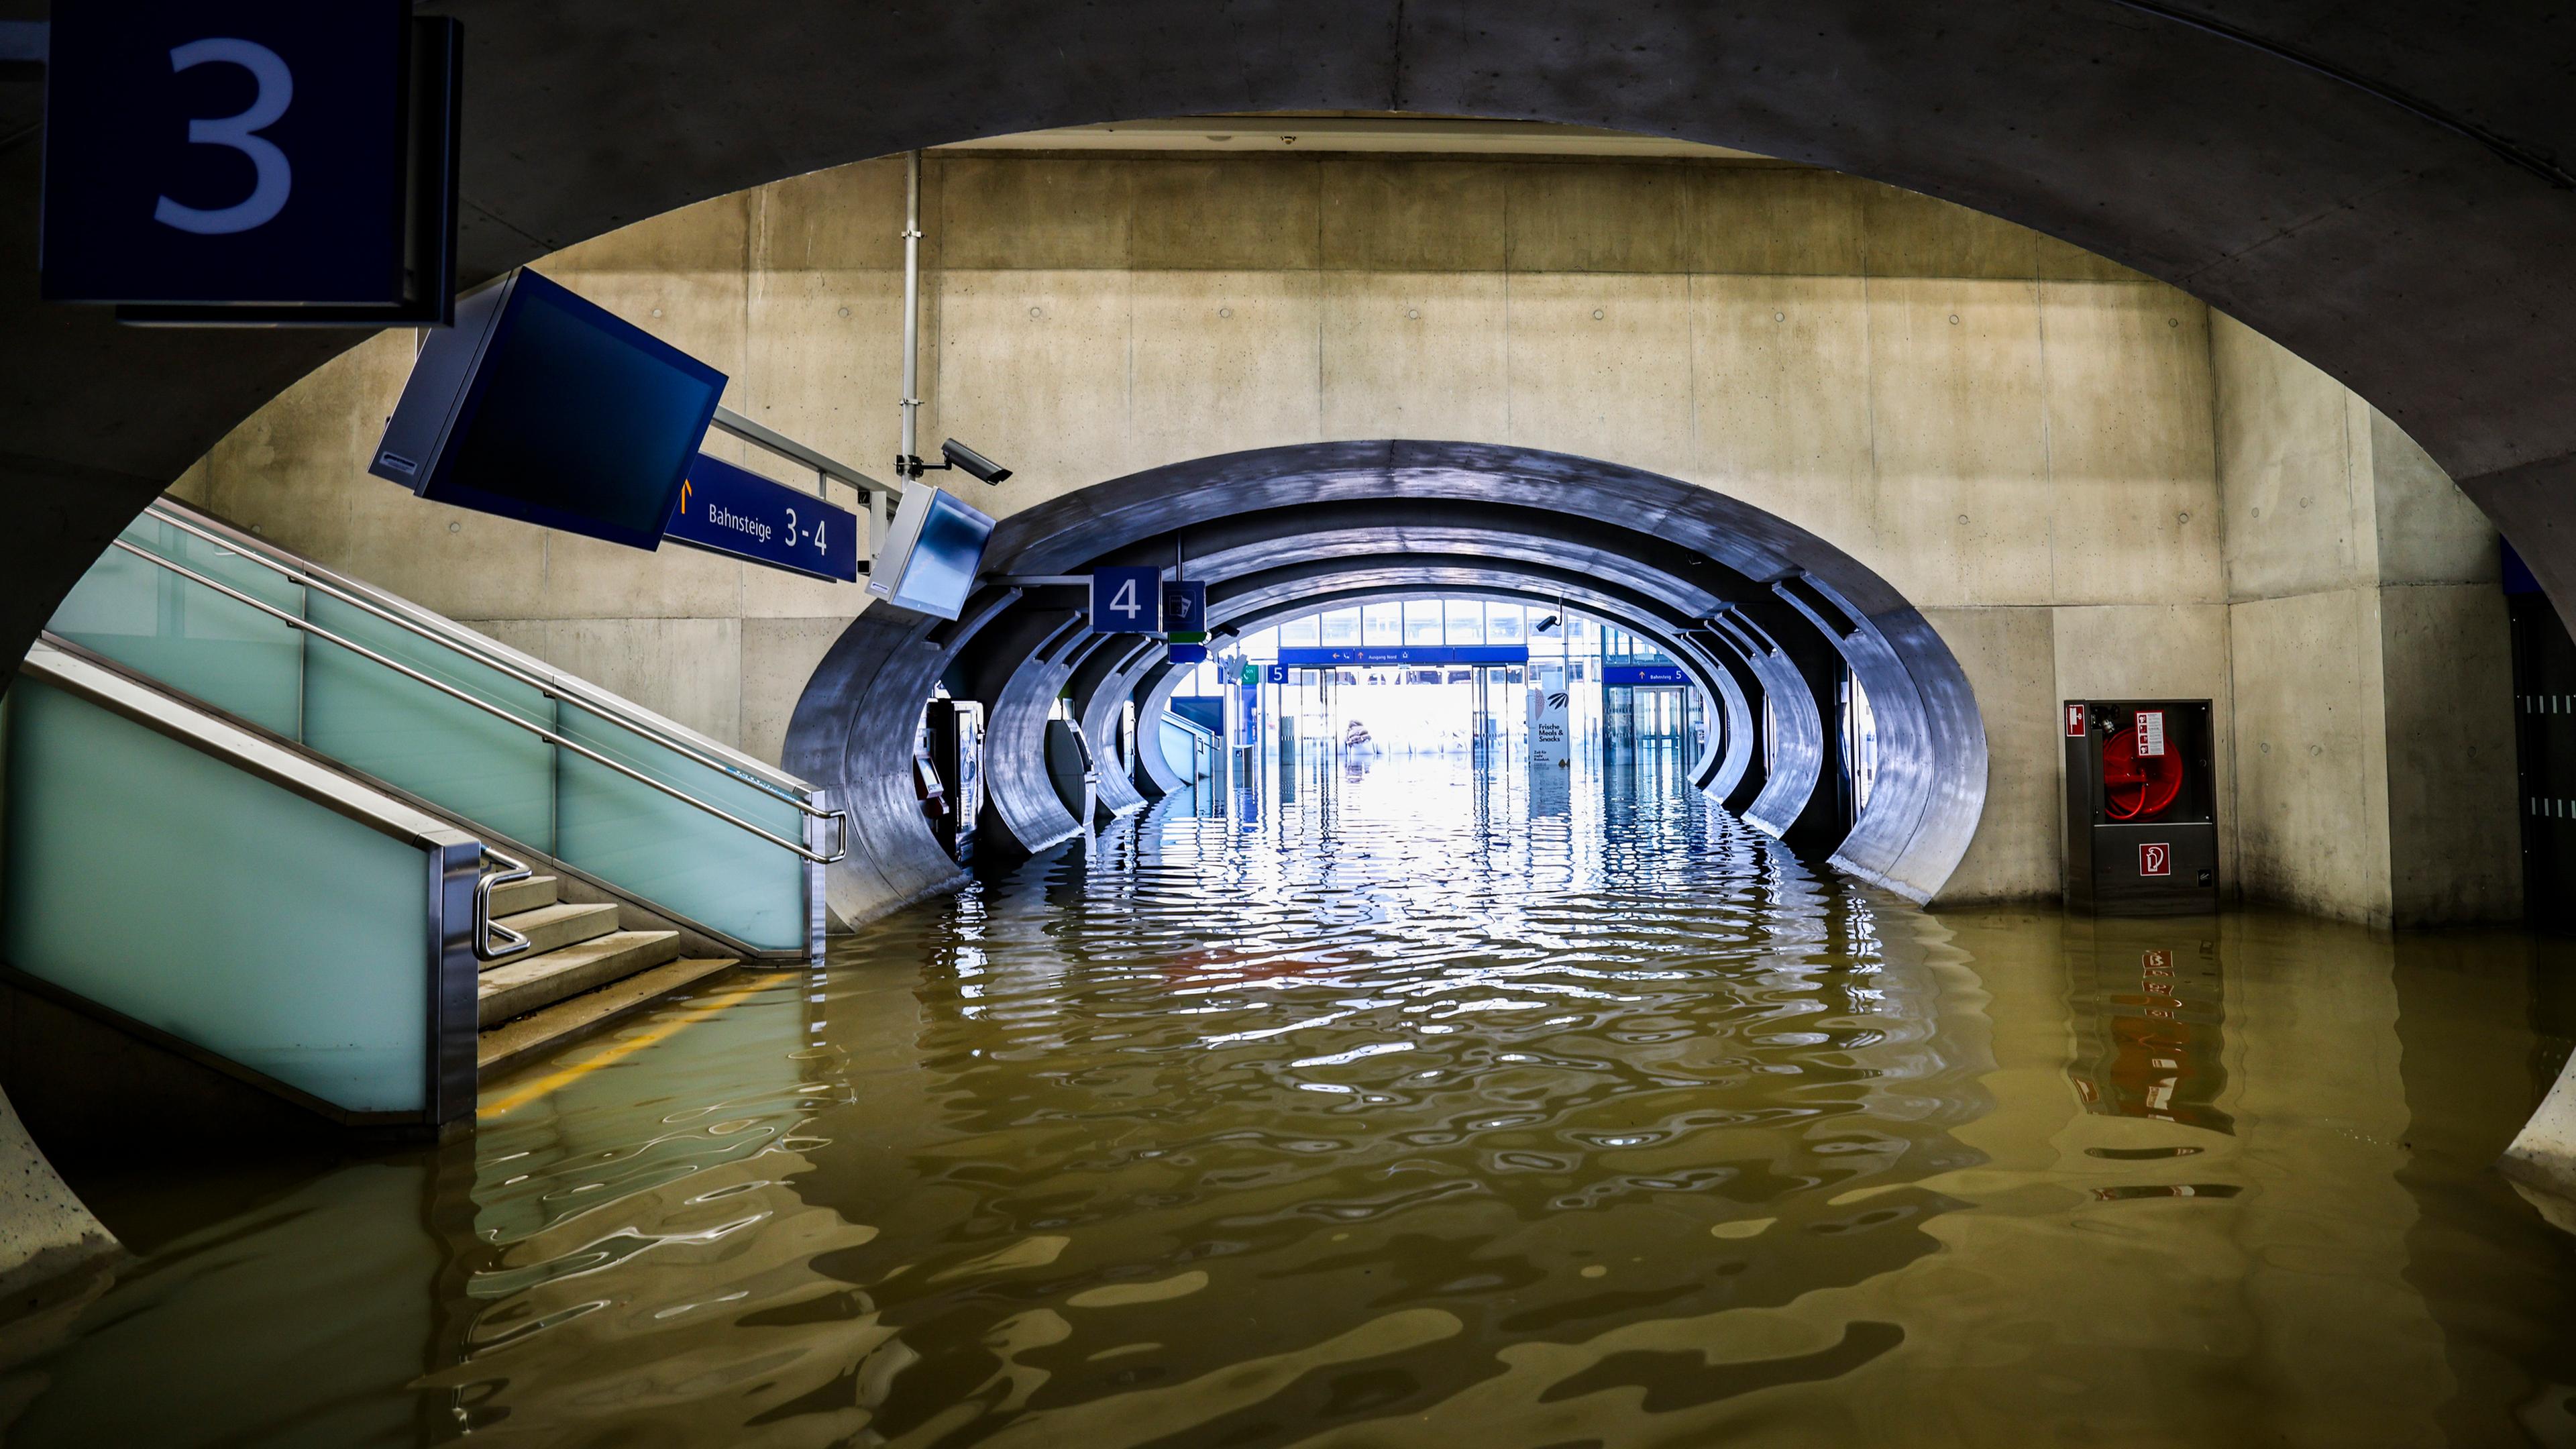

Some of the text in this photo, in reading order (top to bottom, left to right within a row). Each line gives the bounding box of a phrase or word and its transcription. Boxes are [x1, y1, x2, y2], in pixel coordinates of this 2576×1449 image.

[154, 38, 293, 234] 3
[709, 504, 771, 543] Bahnsteige
[1110, 579, 1141, 619] 4
[1274, 667, 1283, 681] 5
[1676, 670, 1682, 680] 5
